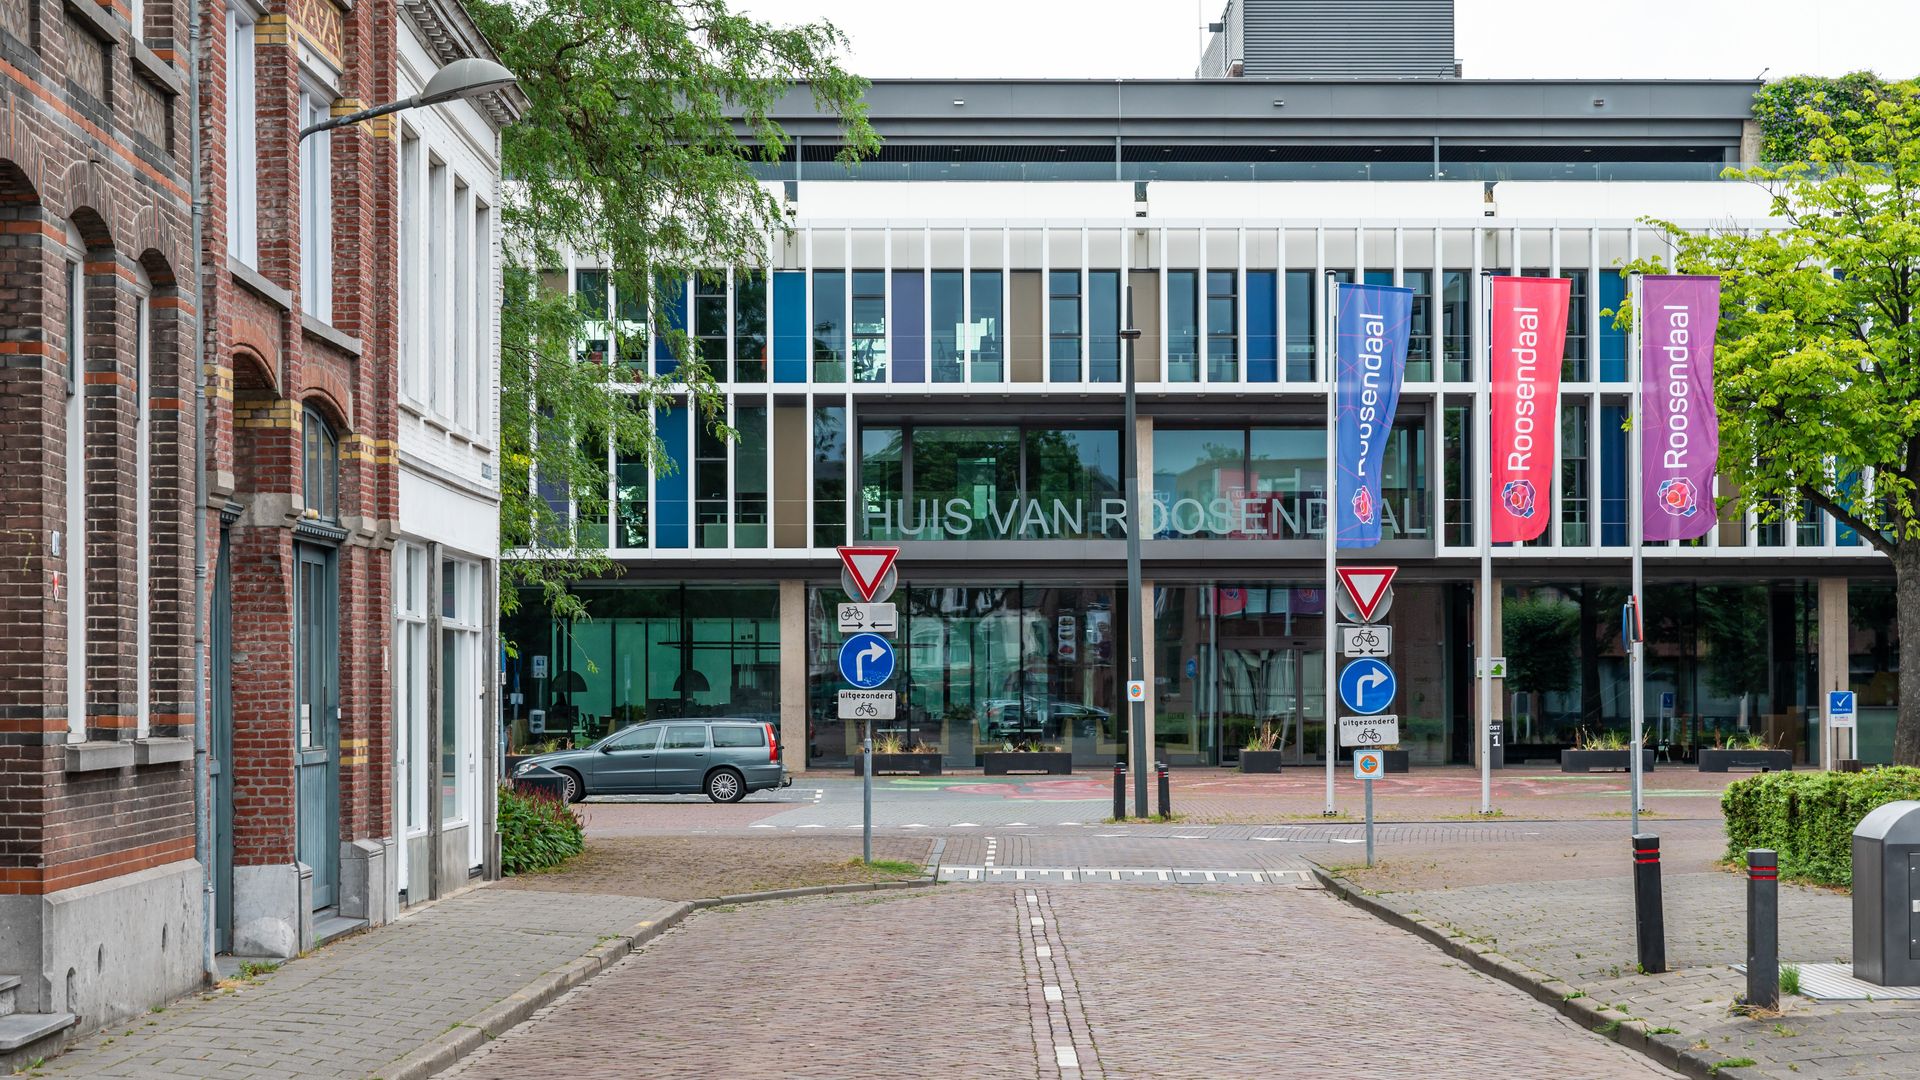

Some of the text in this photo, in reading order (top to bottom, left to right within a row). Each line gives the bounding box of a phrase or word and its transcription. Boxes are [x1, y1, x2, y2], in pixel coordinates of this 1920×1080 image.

[1507, 307, 1539, 471] Roosendaal
[1662, 305, 1689, 469] Roosendaal
[863, 498, 1427, 535] HUIS VAN ROOSENDAL
[840, 691, 893, 700] uitgezonderd
[1342, 718, 1395, 727] uitgezonderd
[1492, 735, 1501, 747] 1
